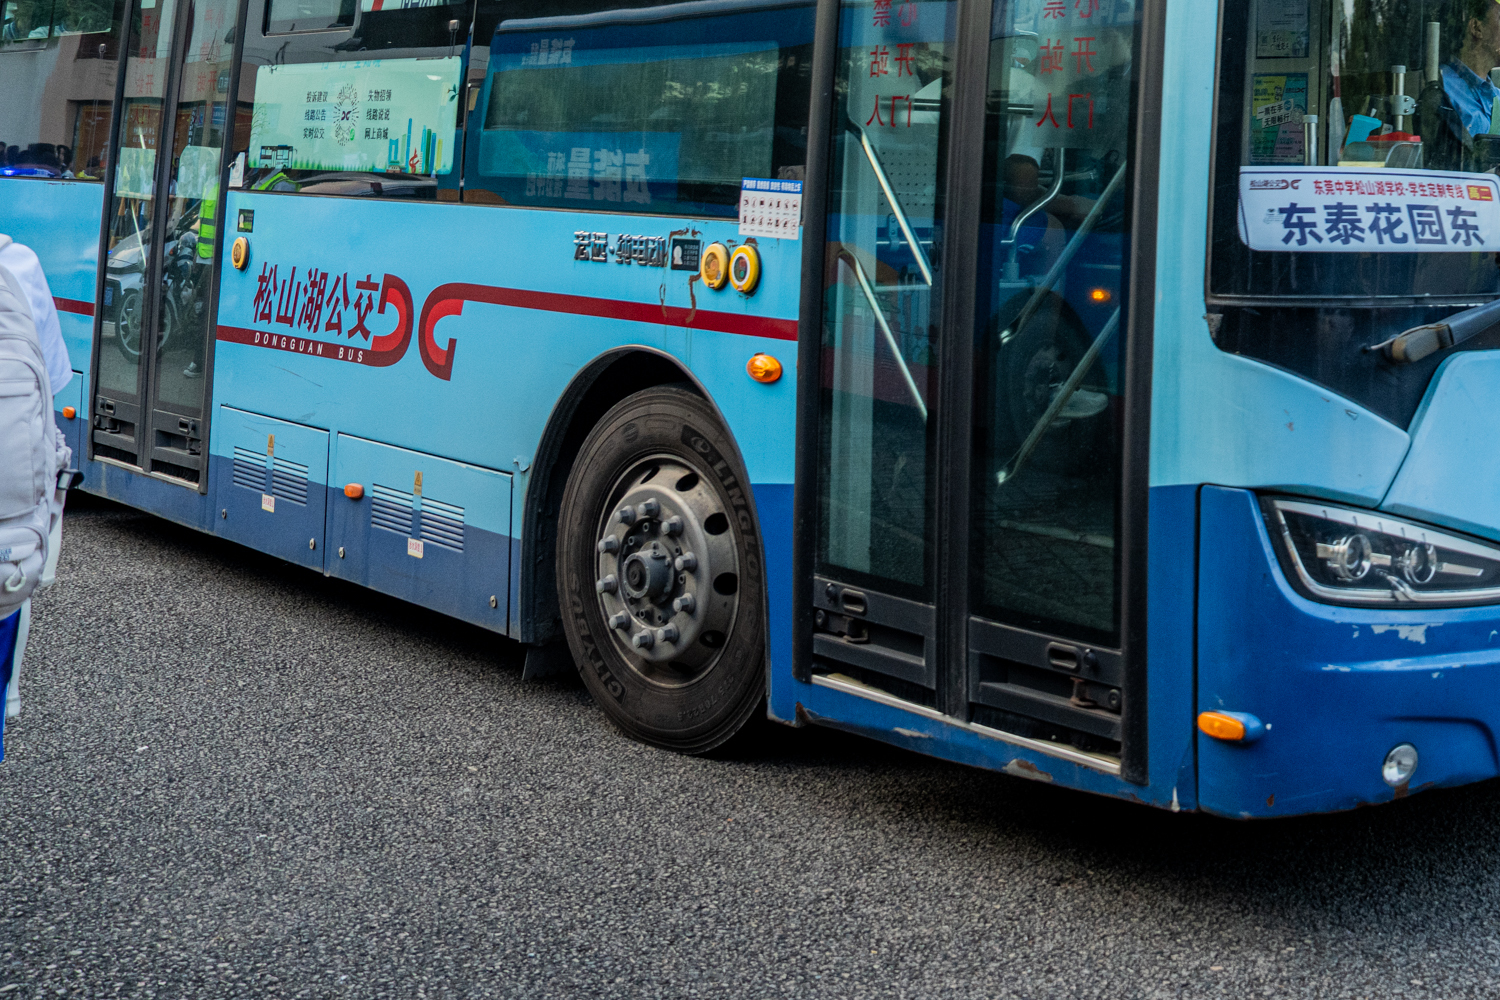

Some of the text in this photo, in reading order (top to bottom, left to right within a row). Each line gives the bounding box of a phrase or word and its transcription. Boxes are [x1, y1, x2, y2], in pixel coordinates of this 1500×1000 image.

[306, 91, 328, 103] 投诉建议
[304, 109, 326, 121] 线路公告
[303, 127, 325, 140] 实时公交
[364, 127, 389, 140] 网上商城
[1469, 186, 1492, 200] 高二
[1279, 202, 1485, 246] 东泰花园东
[253, 261, 380, 342] 松山湖公交
[254, 332, 364, 363] DONGGUAN BUS
[569, 572, 622, 698] CITYBUS
